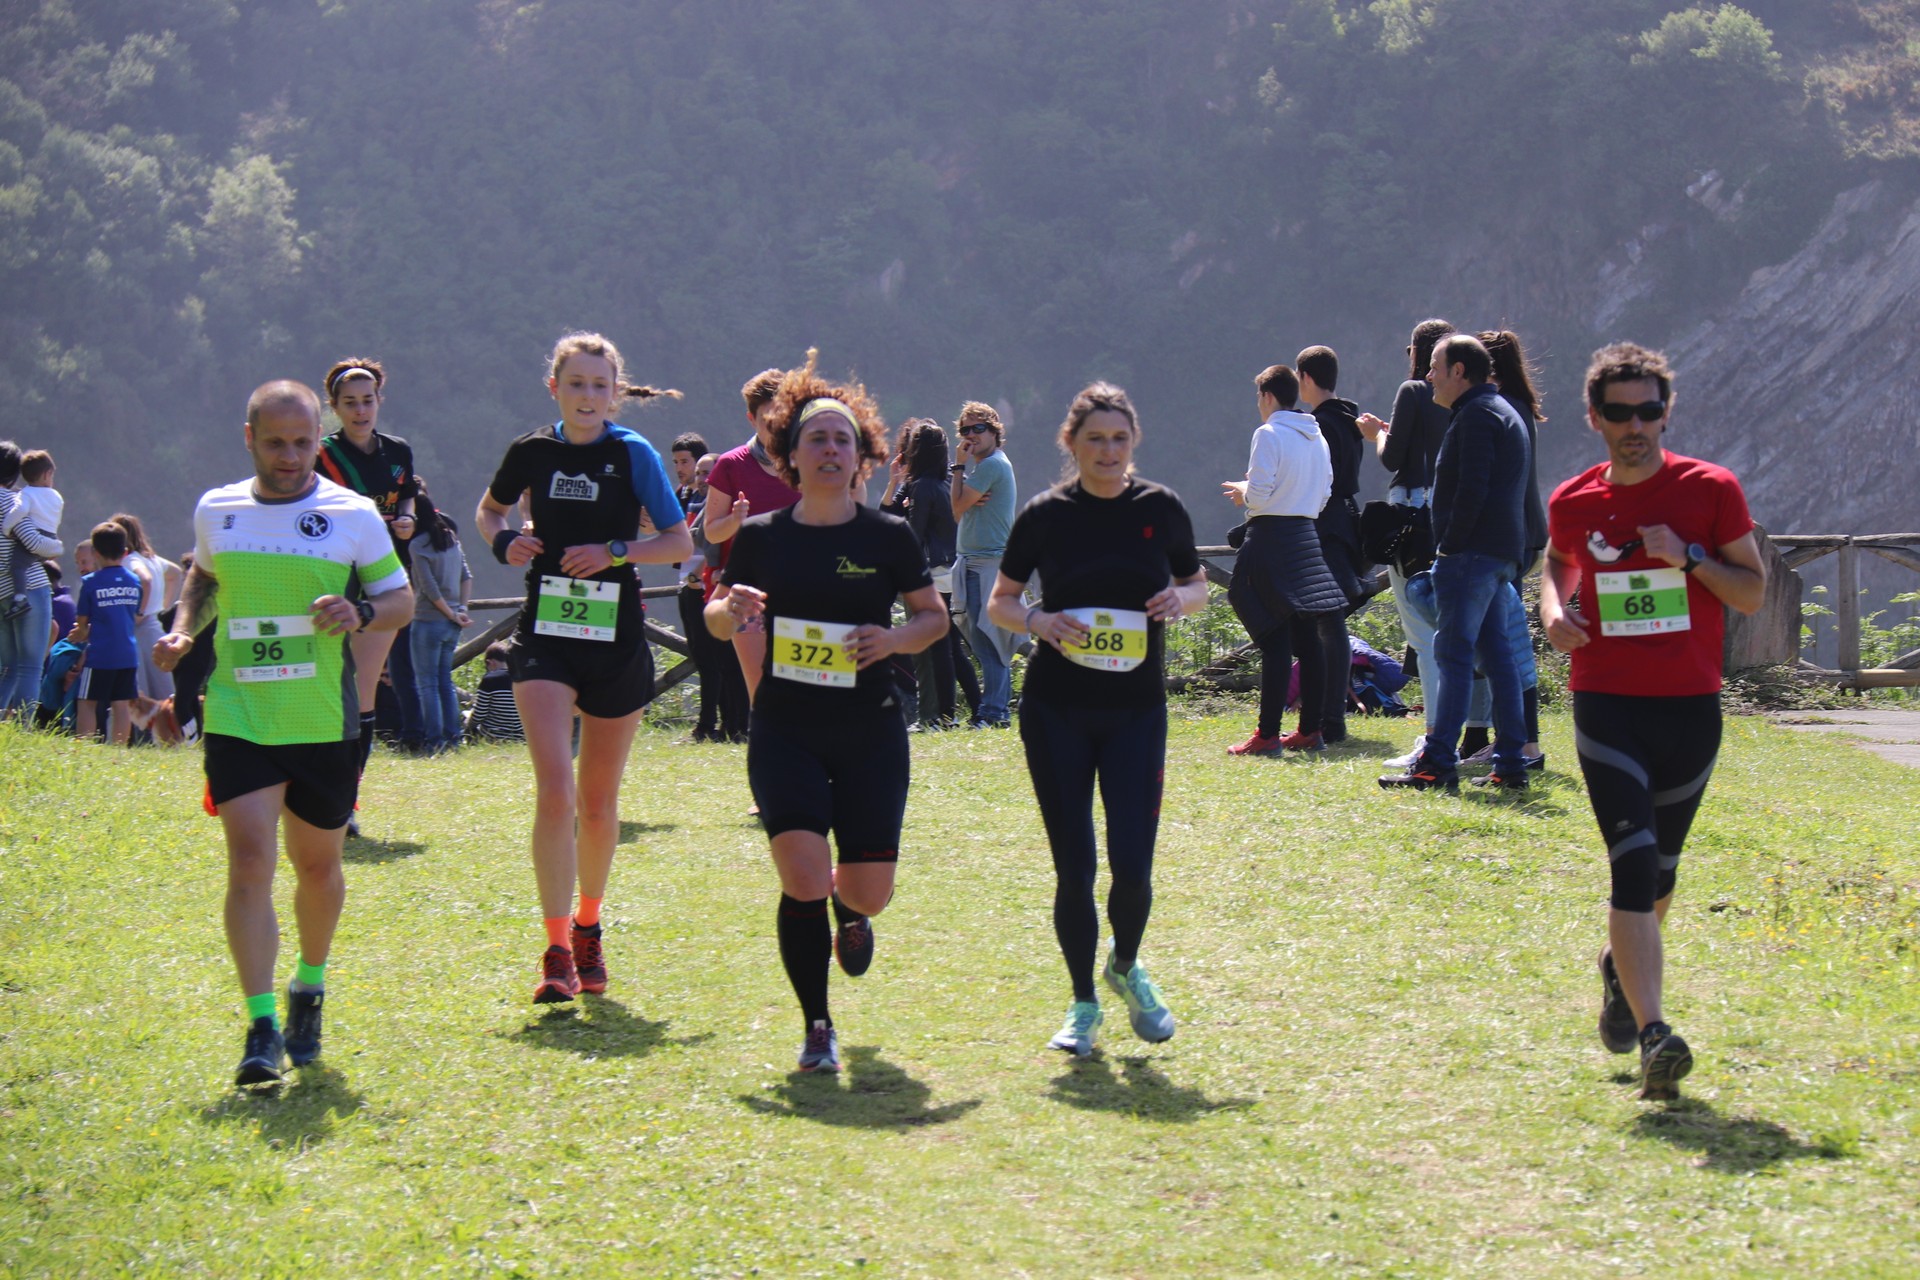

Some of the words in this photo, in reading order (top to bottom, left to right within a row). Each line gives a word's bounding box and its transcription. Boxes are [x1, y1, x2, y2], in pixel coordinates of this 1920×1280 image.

[96, 586, 139, 599] macron
[561, 600, 589, 620] 92
[1624, 594, 1656, 616] 68
[252, 640, 284, 662] 96
[1079, 631, 1124, 652] 368
[790, 643, 834, 666] 372
